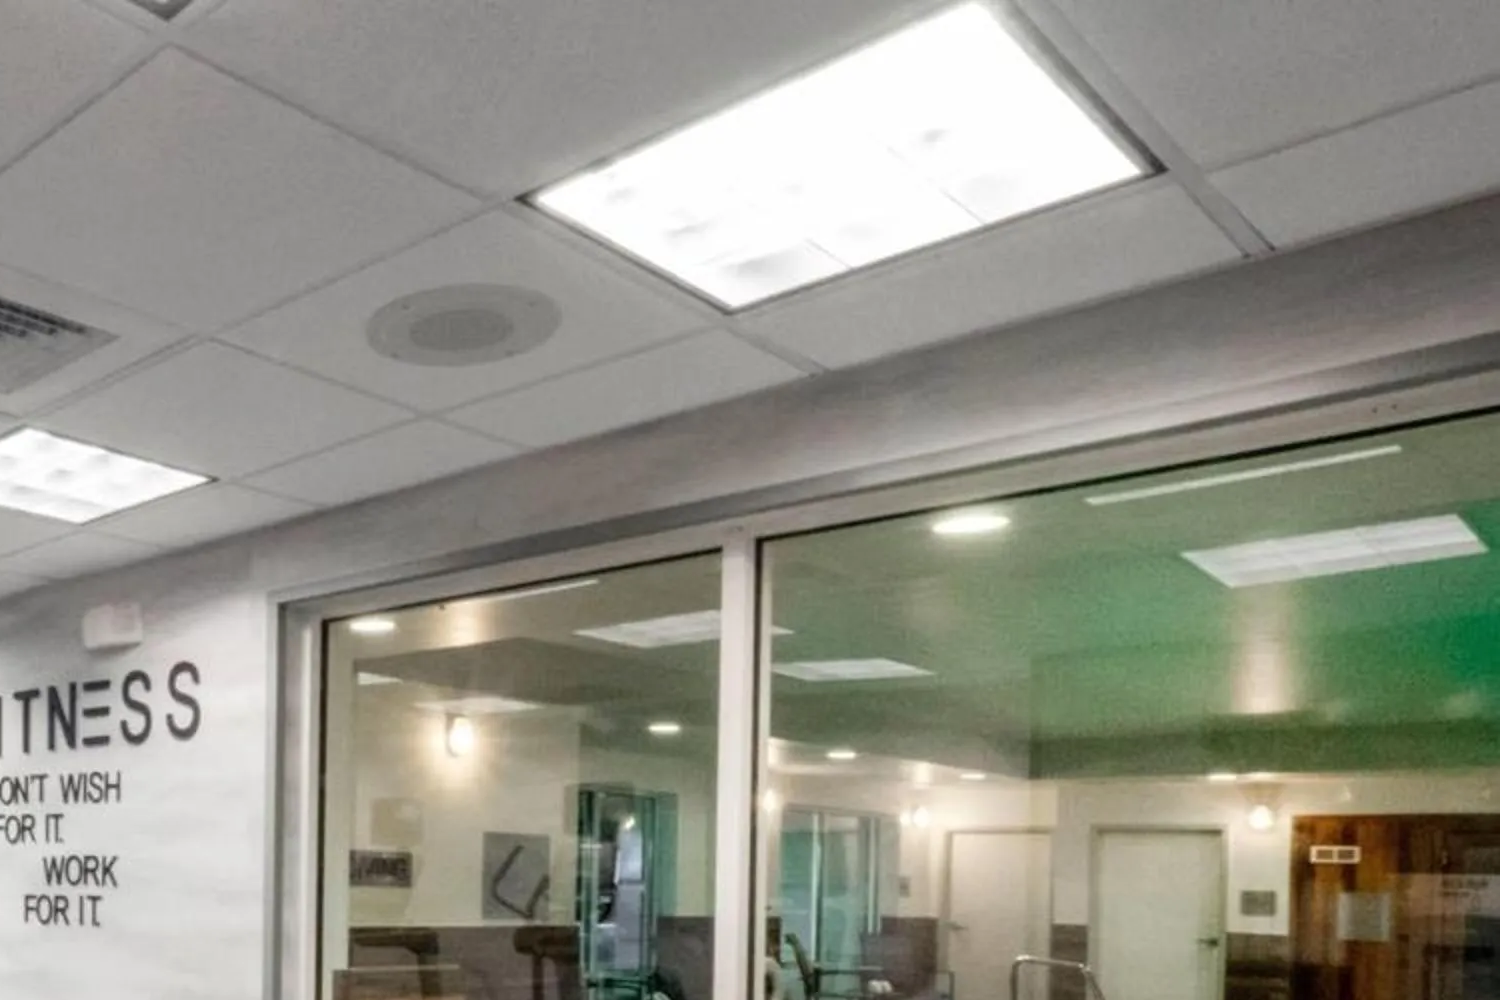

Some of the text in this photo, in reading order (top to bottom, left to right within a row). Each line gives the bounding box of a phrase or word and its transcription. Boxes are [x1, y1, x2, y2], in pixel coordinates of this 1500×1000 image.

[59, 771, 122, 805] WISH
[45, 813, 65, 844] IT.
[43, 855, 119, 888] WORK
[24, 895, 103, 927] FOR IT.
